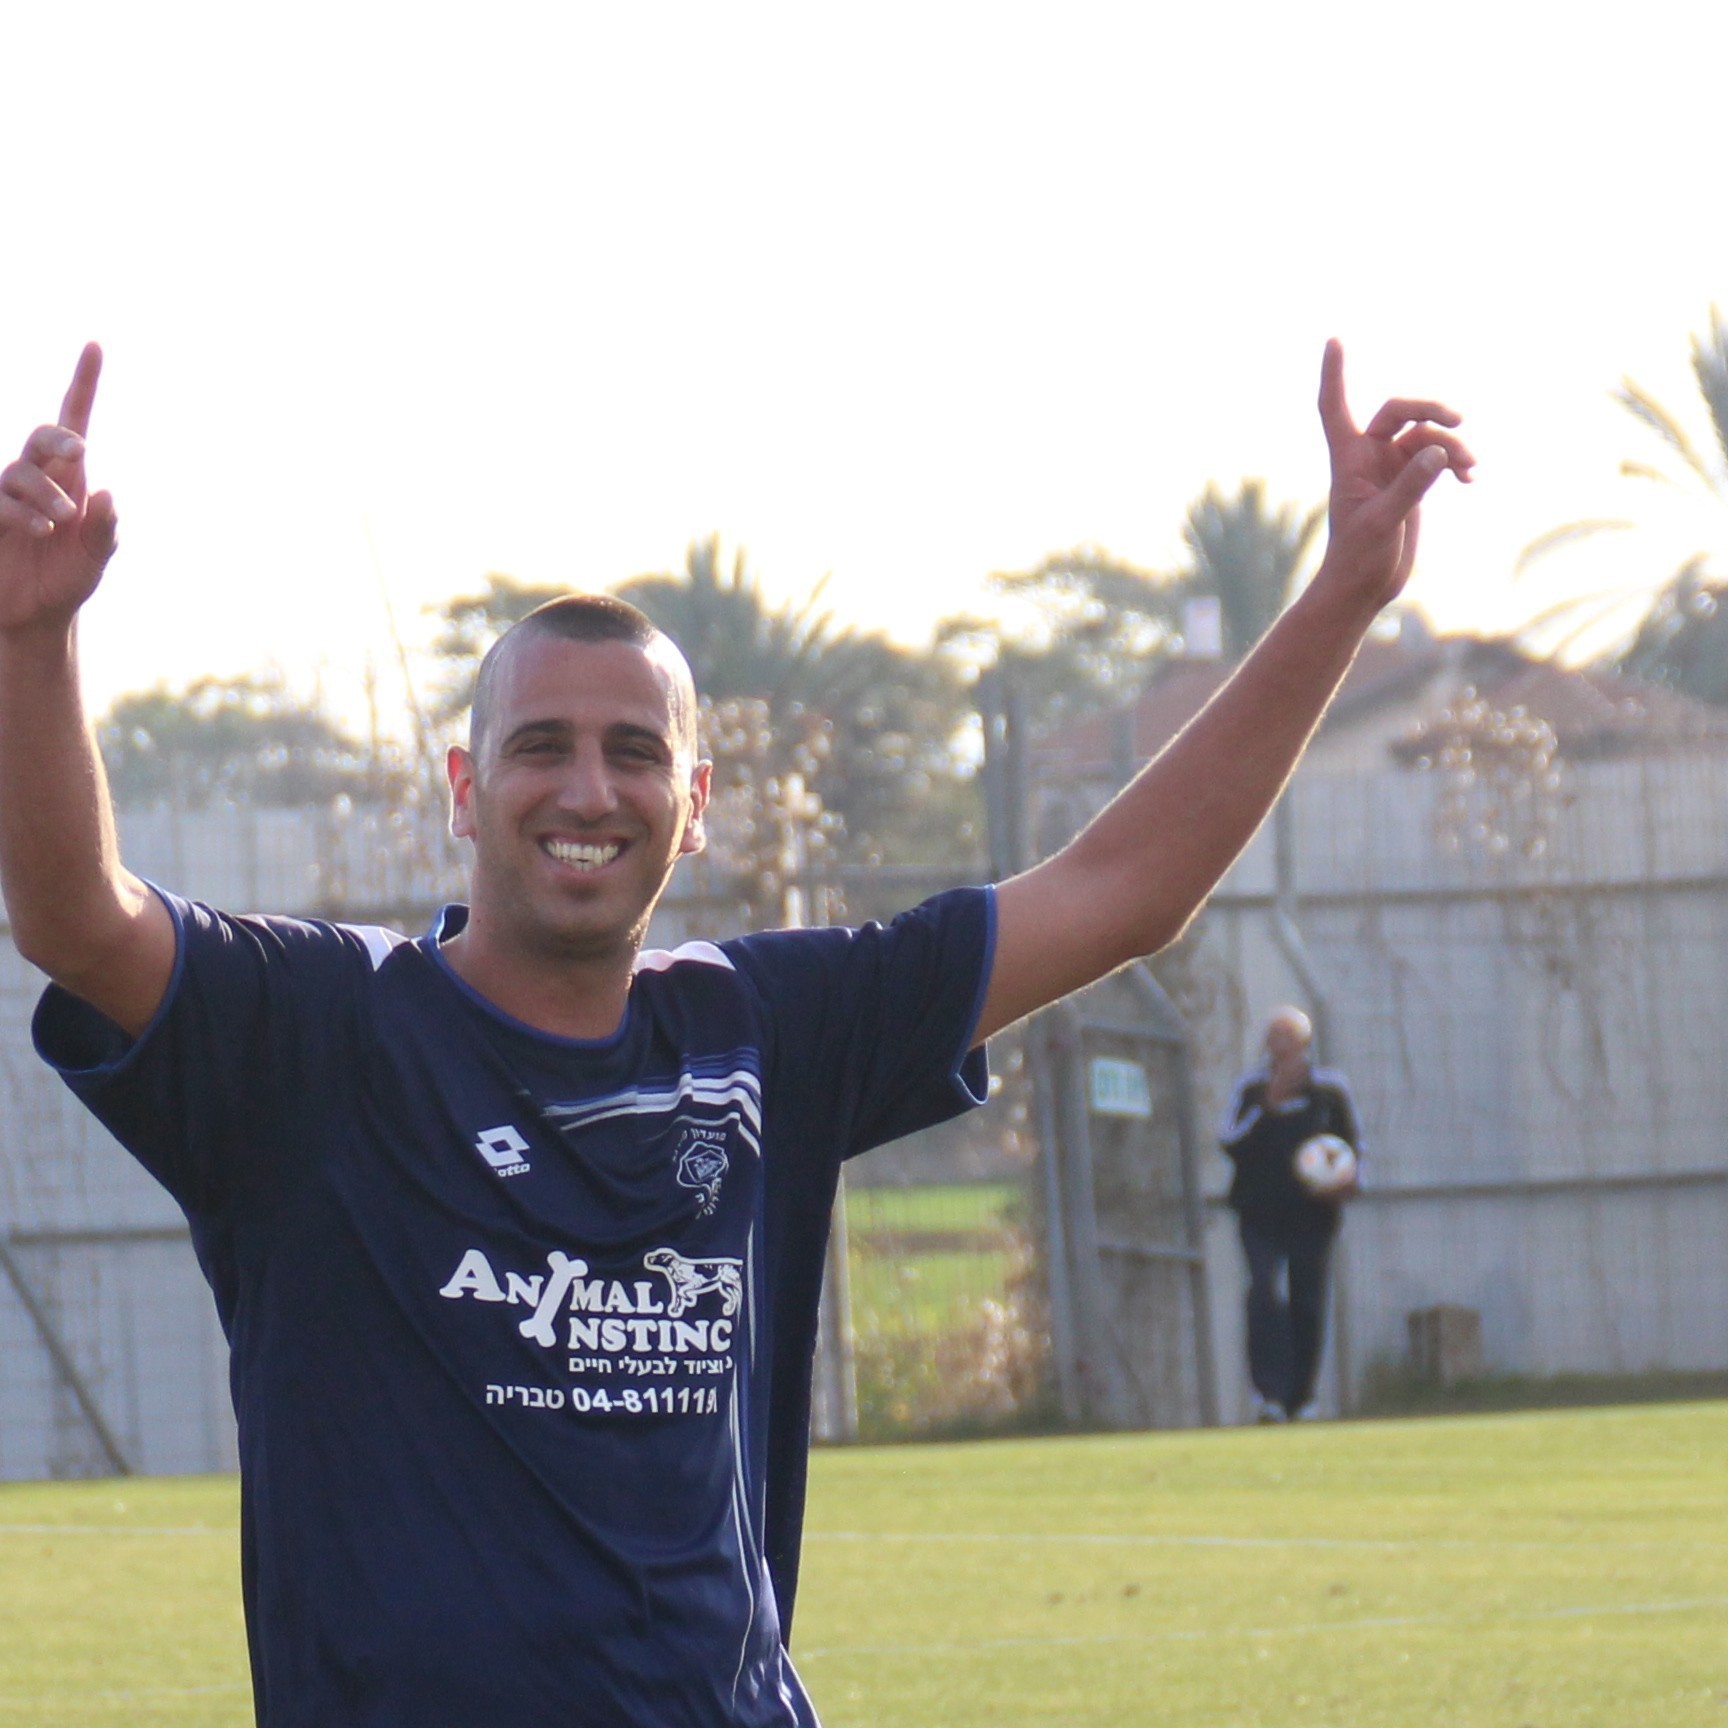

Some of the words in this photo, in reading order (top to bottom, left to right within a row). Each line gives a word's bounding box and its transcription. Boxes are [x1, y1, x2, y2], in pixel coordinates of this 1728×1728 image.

[569, 1357, 612, 1374] חיים
[618, 1355, 677, 1376] לבעלי
[486, 1384, 565, 1409] טבריה
